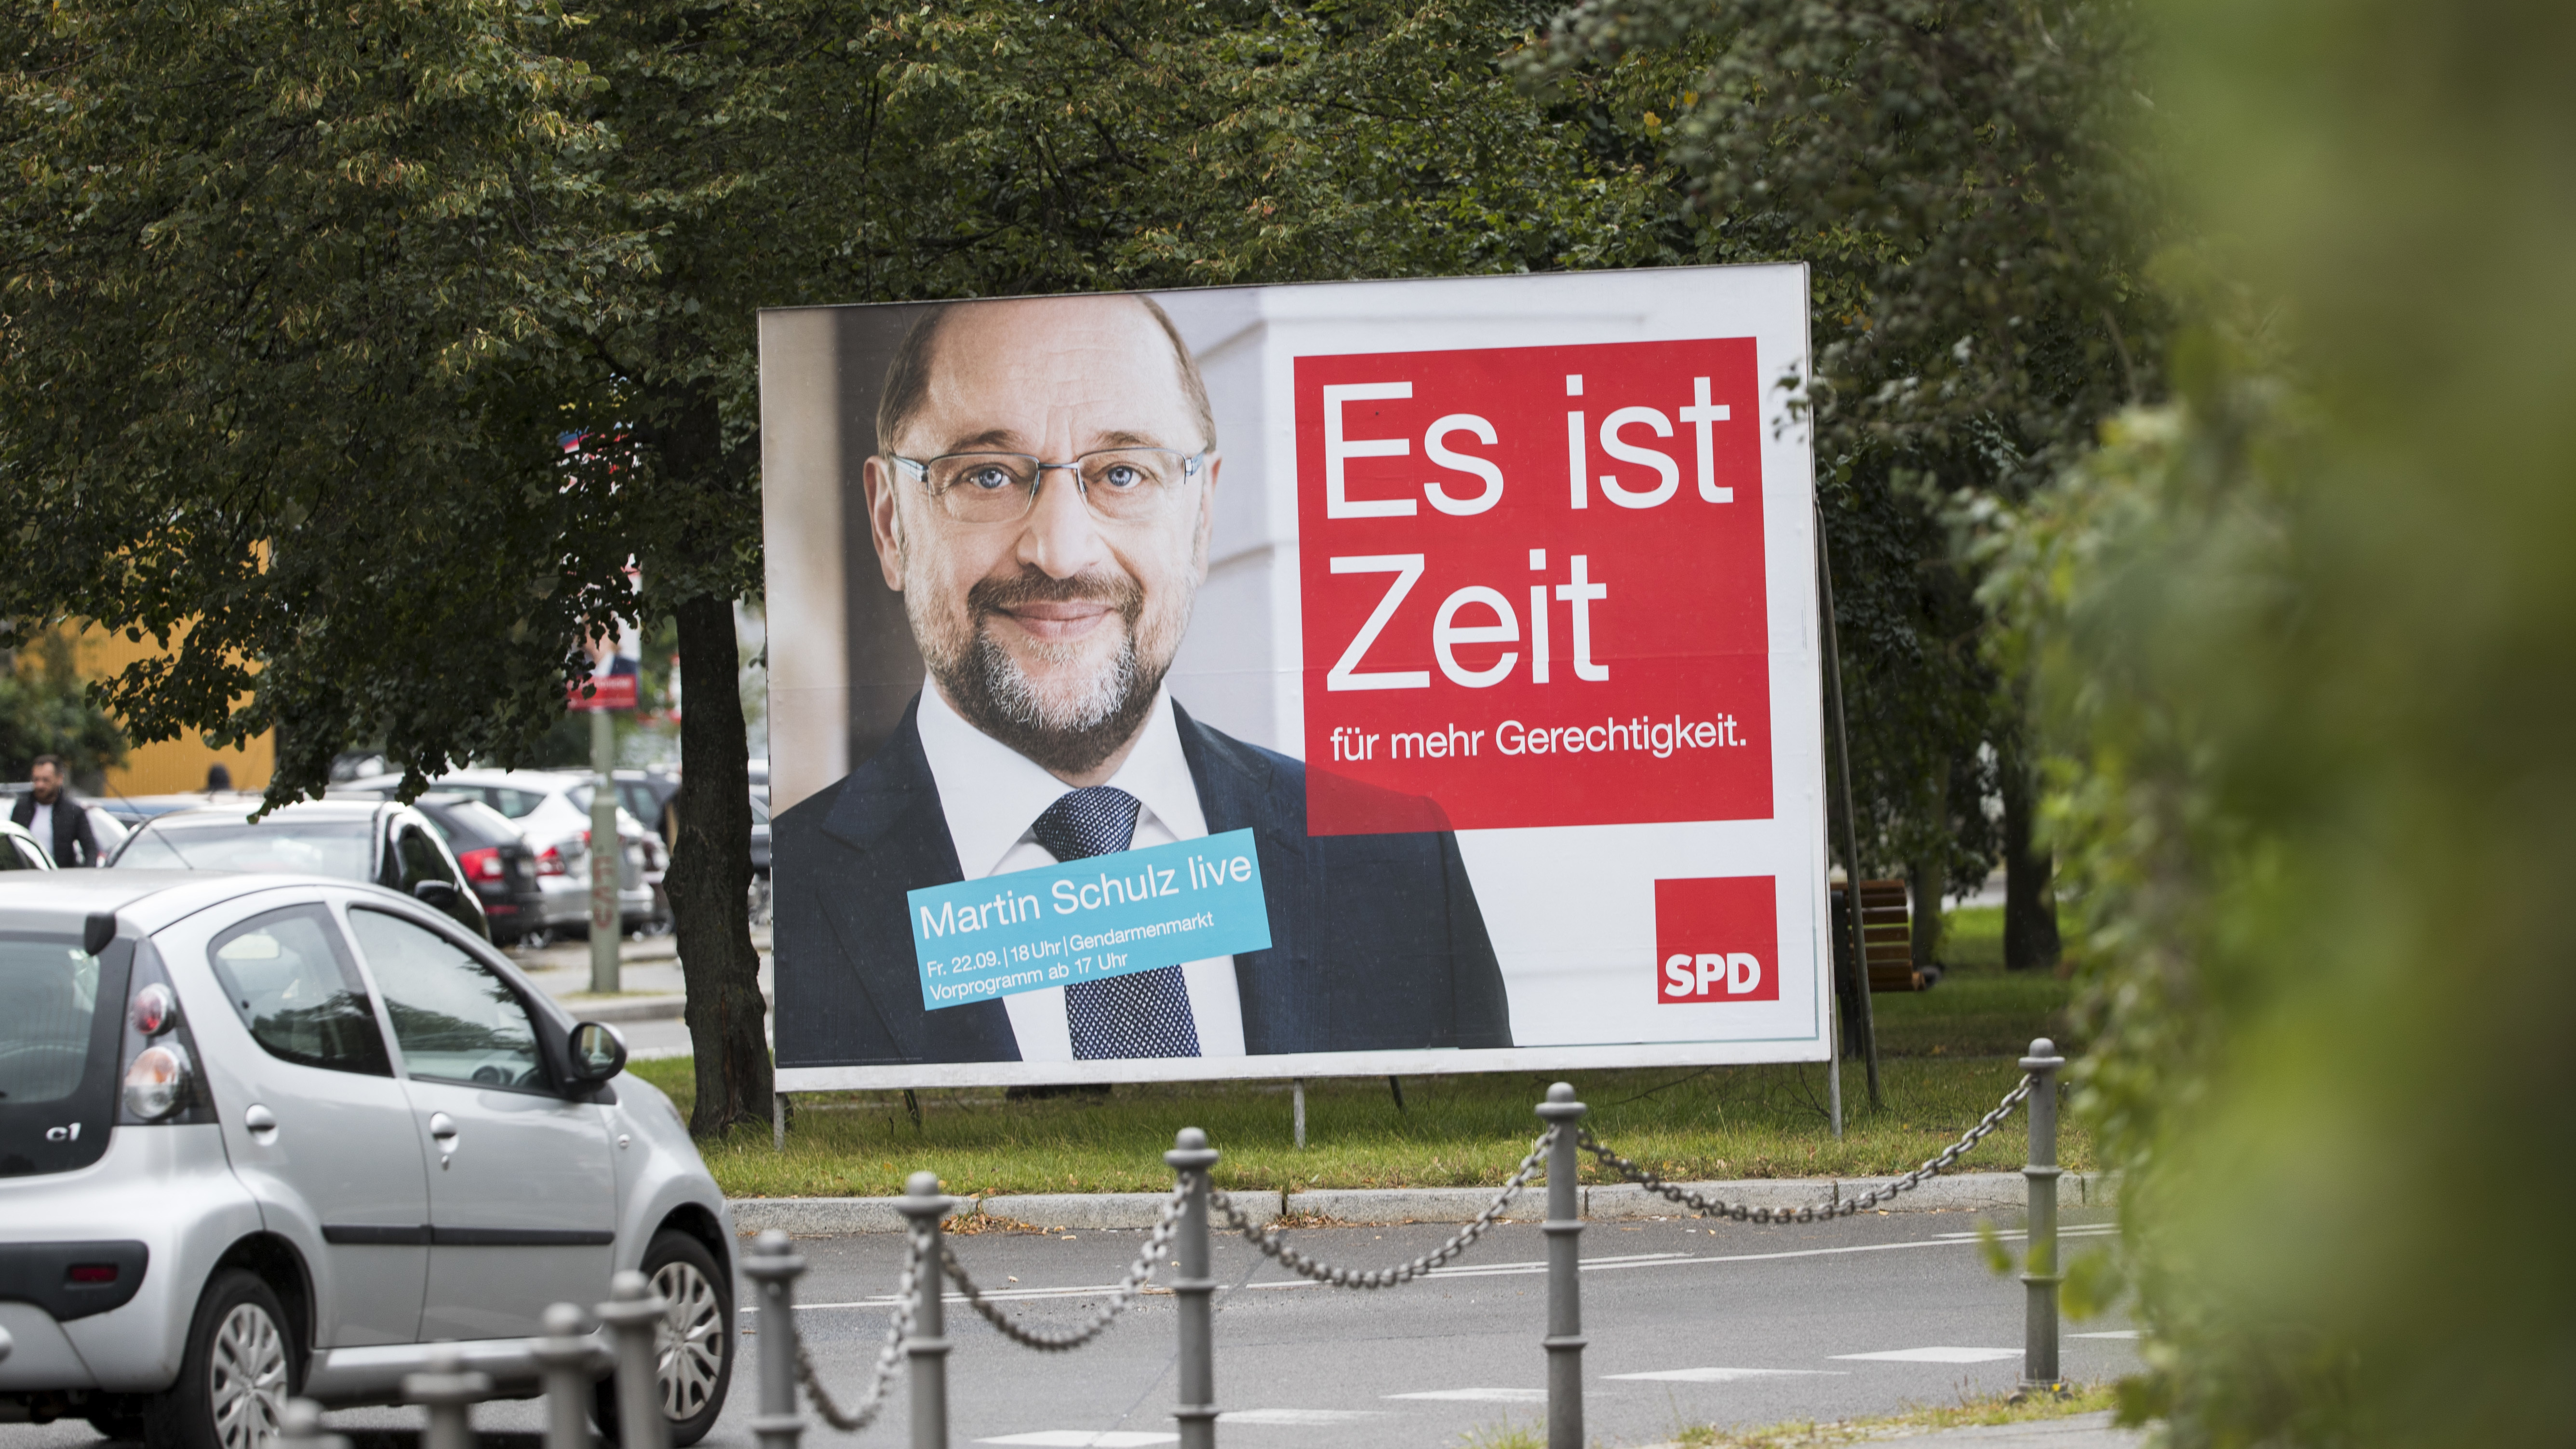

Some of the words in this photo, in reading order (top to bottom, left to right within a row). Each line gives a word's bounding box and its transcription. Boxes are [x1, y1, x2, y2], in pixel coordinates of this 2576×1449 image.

[1323, 381, 1504, 519] Es
[1566, 374, 1733, 510] ist
[1327, 548, 1609, 692] Zeit
[1330, 727, 1380, 761] für
[1391, 723, 1485, 759] mehr
[1496, 713, 1746, 758] Gerechtigkeit.
[920, 890, 1040, 939] Martin
[1051, 864, 1180, 914] Schulz
[1188, 855, 1252, 890] live
[926, 960, 947, 978] Fr.
[951, 951, 1001, 974] 22.09.
[1010, 944, 1030, 962] 18
[1031, 940, 1061, 959] Uhr
[1070, 911, 1214, 952] Gendarmenmarkt
[929, 969, 1043, 1001] Vorprogramm
[1048, 962, 1069, 980] ab
[1074, 956, 1092, 975] 17
[1098, 952, 1128, 970] Uhr
[1664, 953, 1761, 997] SPD
